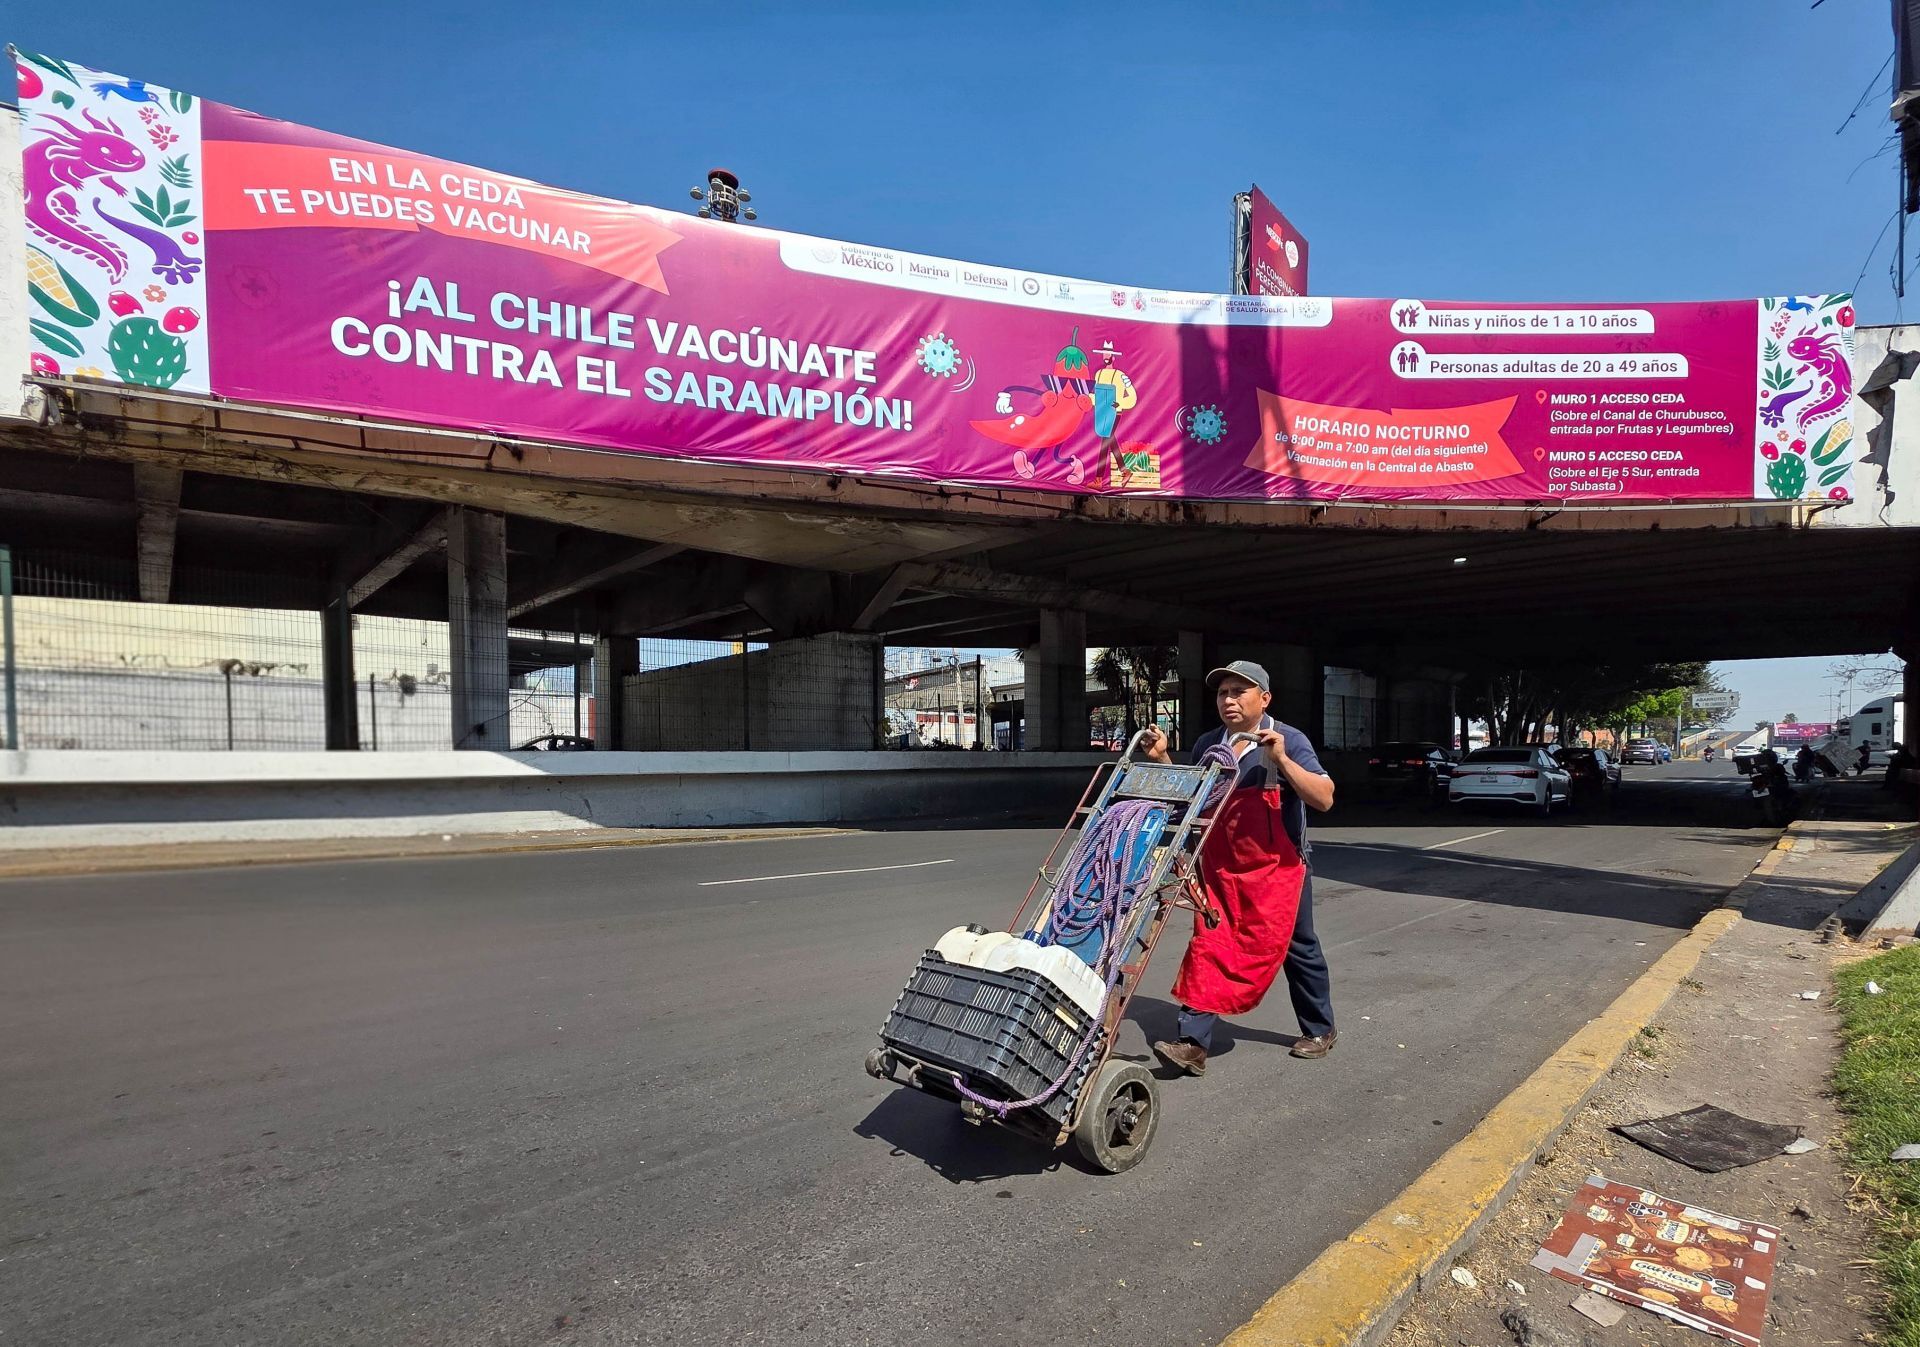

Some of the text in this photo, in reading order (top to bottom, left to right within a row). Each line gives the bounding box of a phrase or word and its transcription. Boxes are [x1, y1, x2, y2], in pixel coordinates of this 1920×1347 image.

[329, 157, 525, 209] EN LA CEDA
[244, 188, 591, 254] TE PUEDES VACUNAR
[842, 252, 894, 272] México
[909, 261, 950, 278] Marina
[1258, 256, 1266, 272] LA
[963, 271, 1008, 287] Defensa
[1260, 305, 1288, 313] PÚBLICA
[387, 275, 876, 383] ¡AL CHILE VACÚNATE
[1428, 314, 1637, 330] Niñas y niños de 1 a 10 años
[330, 316, 913, 432] CONTRA EL SARAMPIÓN!
[1430, 360, 1678, 373] Personas adultas de 20 a 49 años
[1550, 393, 1685, 404] MURO 1 ACCESO CEDA
[1550, 409, 1727, 422] (Sobre el Canal de Churubusco,
[1295, 415, 1470, 440] HORARIO NOCTURNO
[1550, 423, 1734, 436] entrada por Frutas y Legumbres)
[1275, 431, 1488, 458] de 8:00 pm a 7:00 am (del día siguiente)
[1287, 450, 1474, 472] Vacunación en la Central de Abasto
[1549, 451, 1683, 461] MURO 5 ACCESO CEDA
[1549, 467, 1700, 479] (Sobre el Eje 5 Sur, entrada
[1549, 483, 1567, 493] por
[1570, 481, 1616, 491] Subasta
